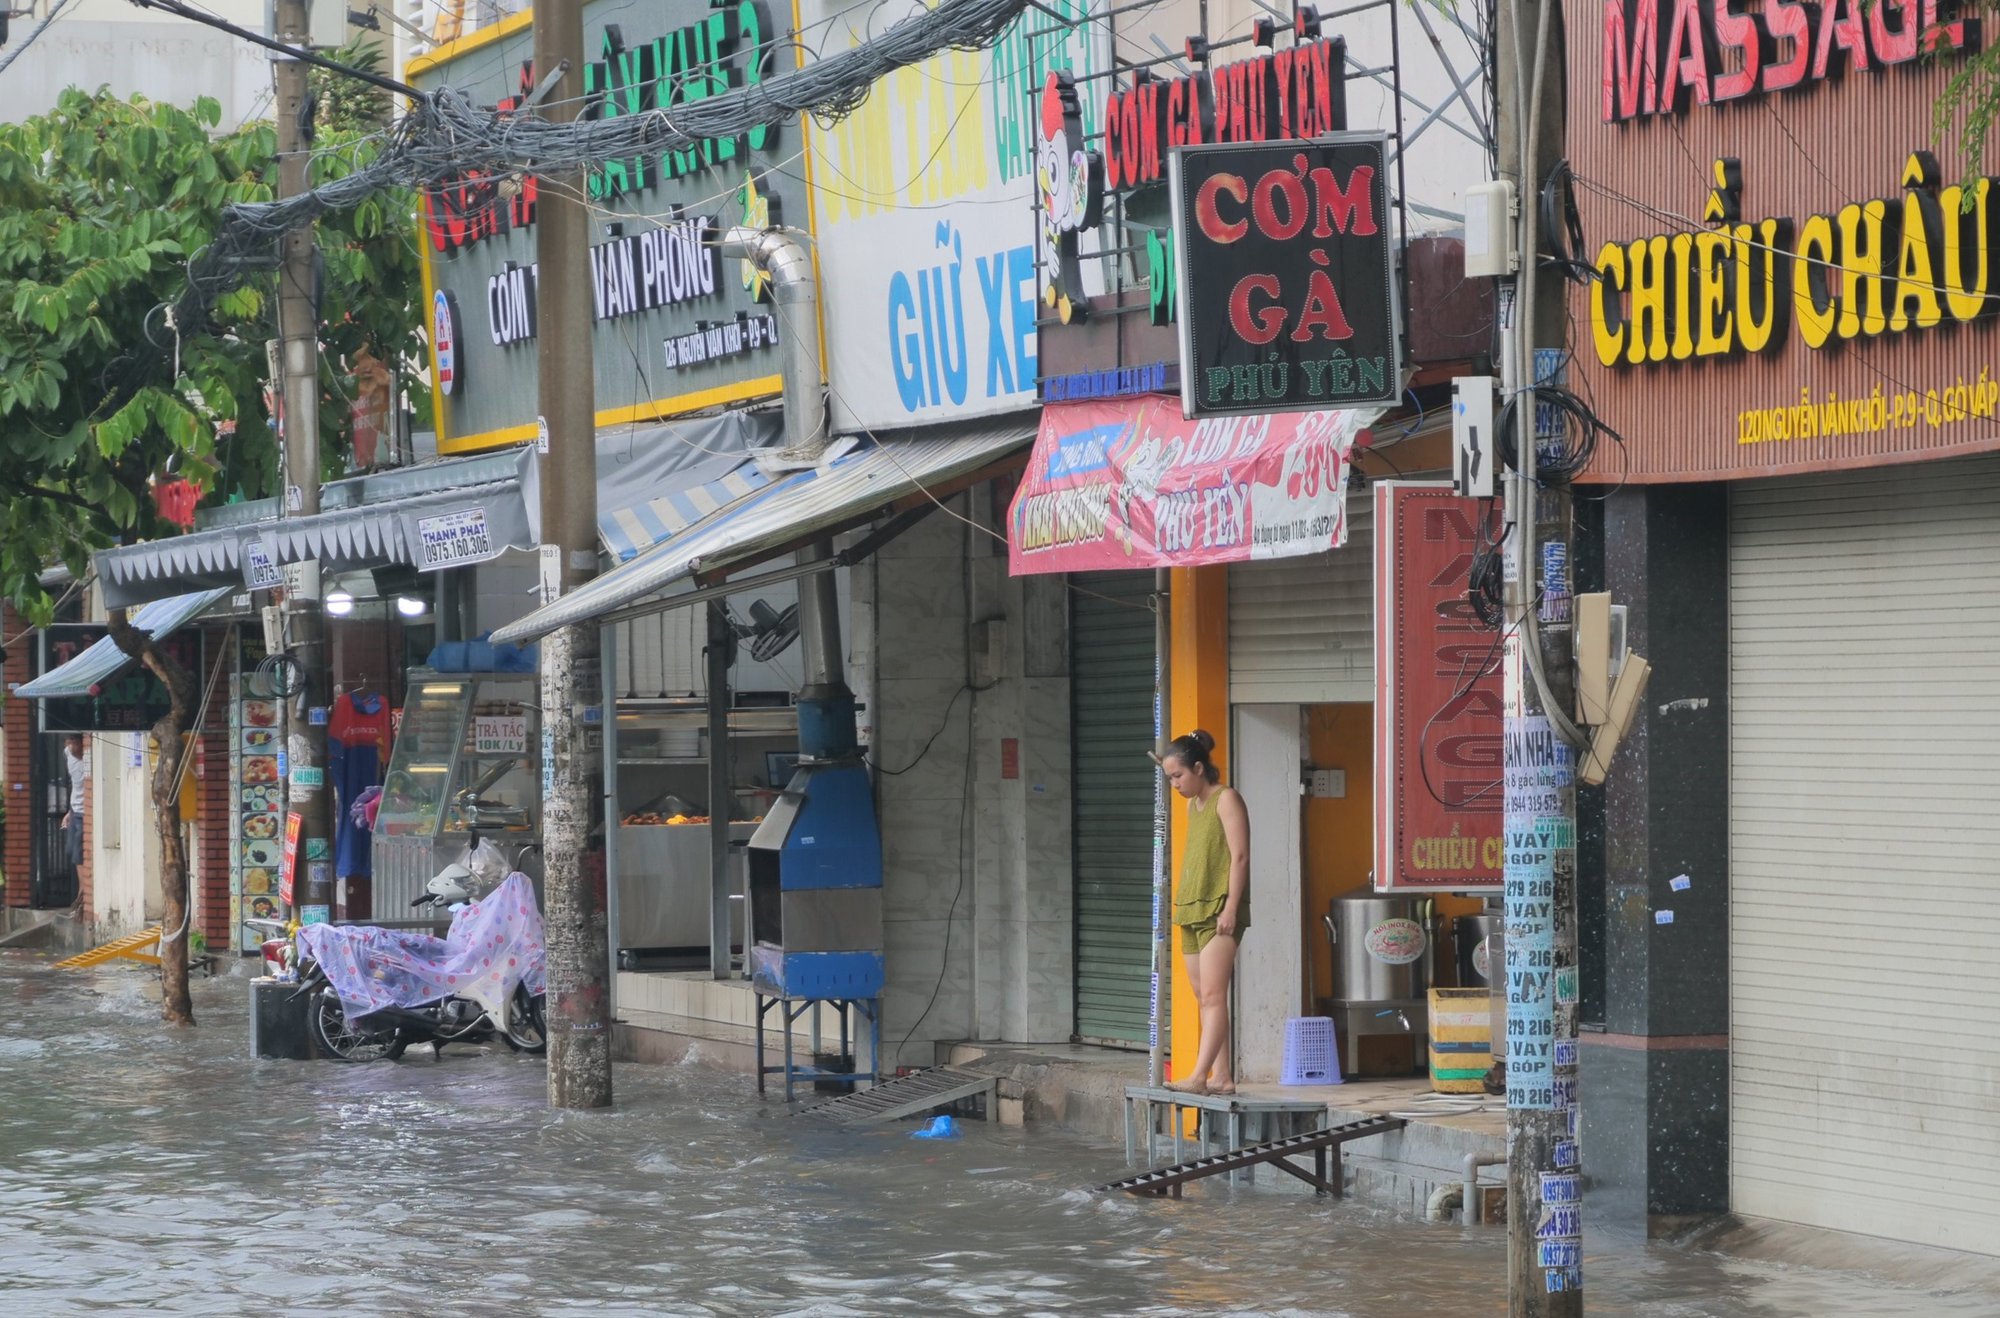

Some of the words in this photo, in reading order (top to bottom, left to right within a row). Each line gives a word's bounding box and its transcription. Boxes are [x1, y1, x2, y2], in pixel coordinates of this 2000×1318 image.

[1105, 67, 1159, 190] CƠM
[1195, 153, 1377, 245] CƠM
[590, 223, 637, 318] VĂN
[641, 205, 714, 308] PHÒNG
[1795, 152, 1989, 350] CHÂU
[488, 261, 530, 345] CƠM
[1228, 248, 1354, 345] GÀ
[888, 219, 967, 413] GIỮ
[975, 244, 1037, 398] XE
[664, 340, 677, 368] 126
[1205, 352, 1289, 403] PHÚ
[1300, 348, 1387, 397] YÊN
[1943, 377, 1966, 423] GÒ
[1968, 364, 1999, 419] VẤP
[1154, 473, 1200, 552] PHÚ
[1203, 467, 1249, 549] YÊN
[423, 528, 457, 543] THANH
[425, 535, 489, 563] 0975.160.306
[477, 720, 498, 737] TRÀ
[502, 718, 523, 737] TẮC
[478, 740, 523, 751] 10K/Ly
[1526, 720, 1554, 767] NHÀ
[1528, 795, 1542, 811] 319
[1513, 833, 1550, 848] VAY
[1511, 852, 1547, 865] GÓP
[1507, 881, 1524, 896] 279
[1529, 880, 1551, 897] 216
[1513, 902, 1550, 918] VAY
[1529, 950, 1551, 967] 216
[1508, 1020, 1525, 1035] 279
[1529, 1019, 1551, 1035] 216
[1513, 1041, 1549, 1056] VAY
[1512, 1058, 1546, 1072] GÓP
[1508, 1089, 1525, 1105] 279
[1529, 1088, 1551, 1105] 216
